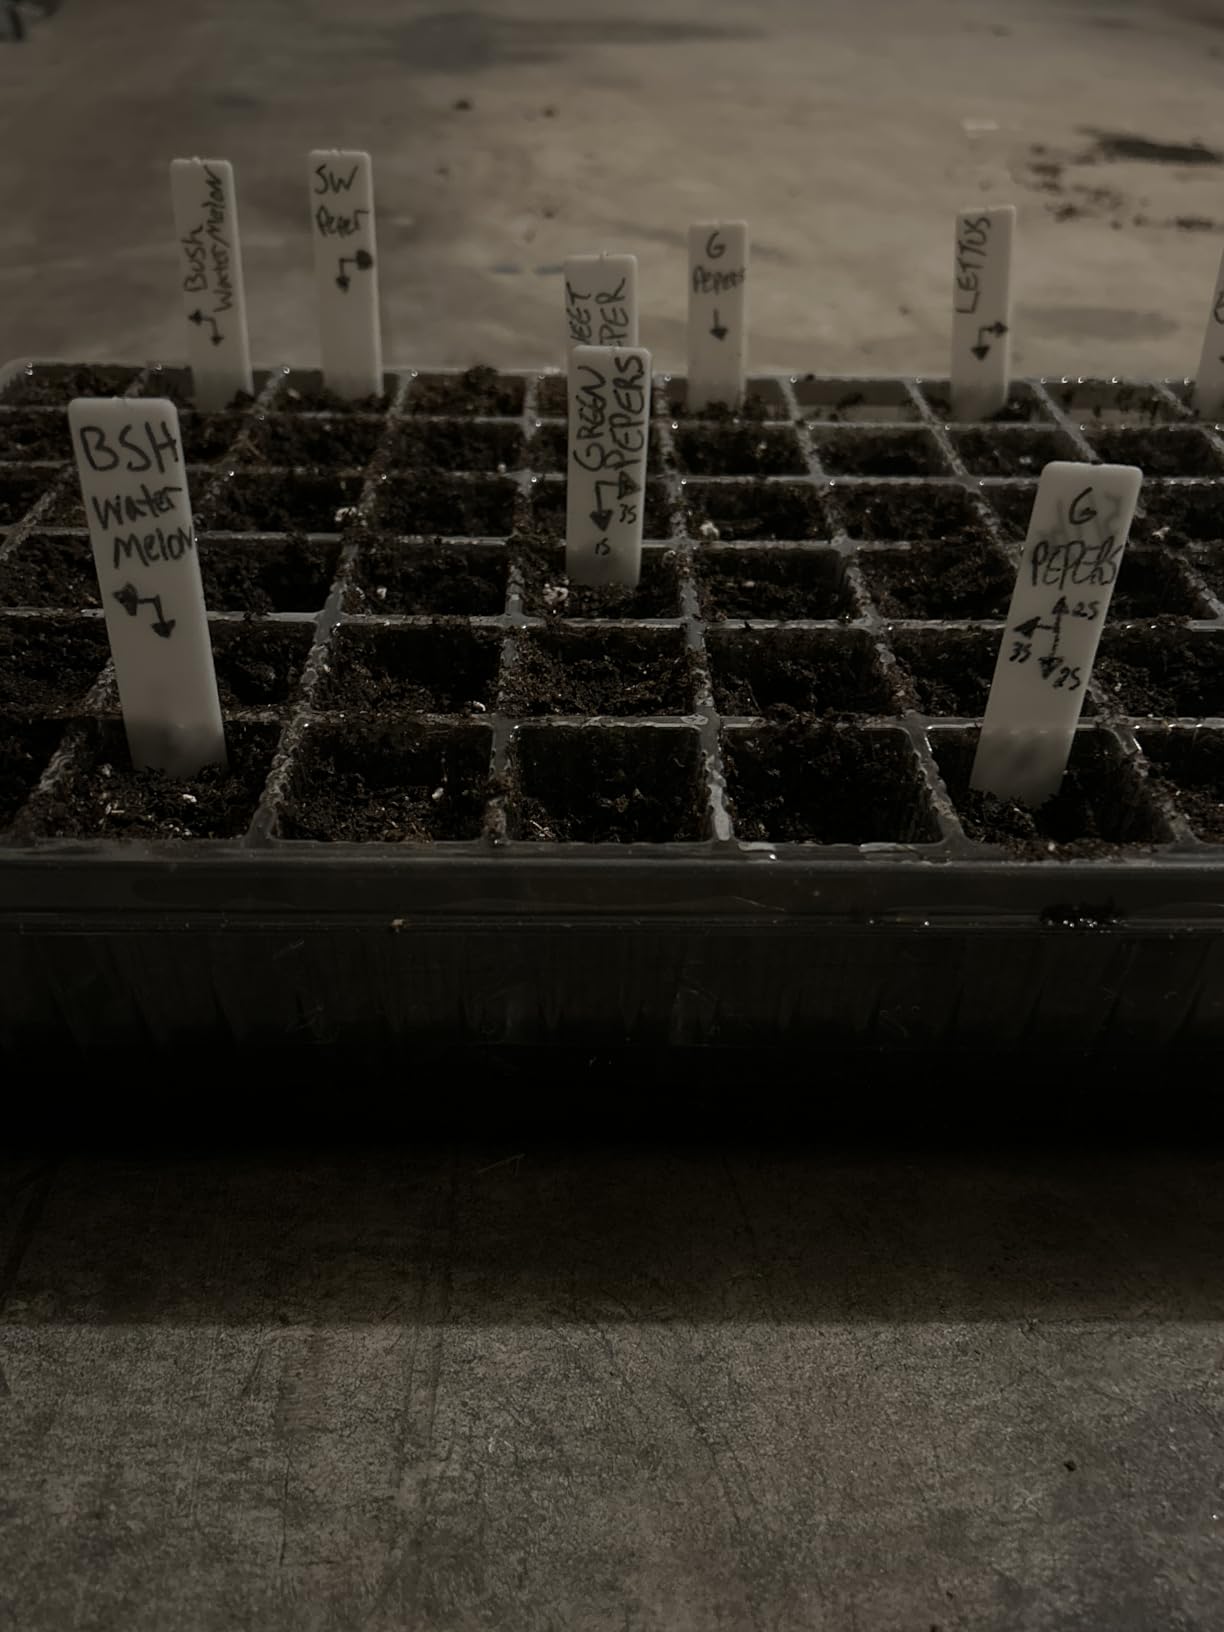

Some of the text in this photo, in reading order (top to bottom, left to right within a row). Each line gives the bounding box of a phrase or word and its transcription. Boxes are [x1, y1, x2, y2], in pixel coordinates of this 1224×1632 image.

[314, 163, 358, 194] SW
[706, 231, 727, 260] G
[956, 215, 991, 315] LETTUS
[573, 364, 607, 471] GREEN
[602, 355, 645, 471] PEPERS
[80, 421, 179, 474] BSH
[1068, 486, 1098, 525] G
